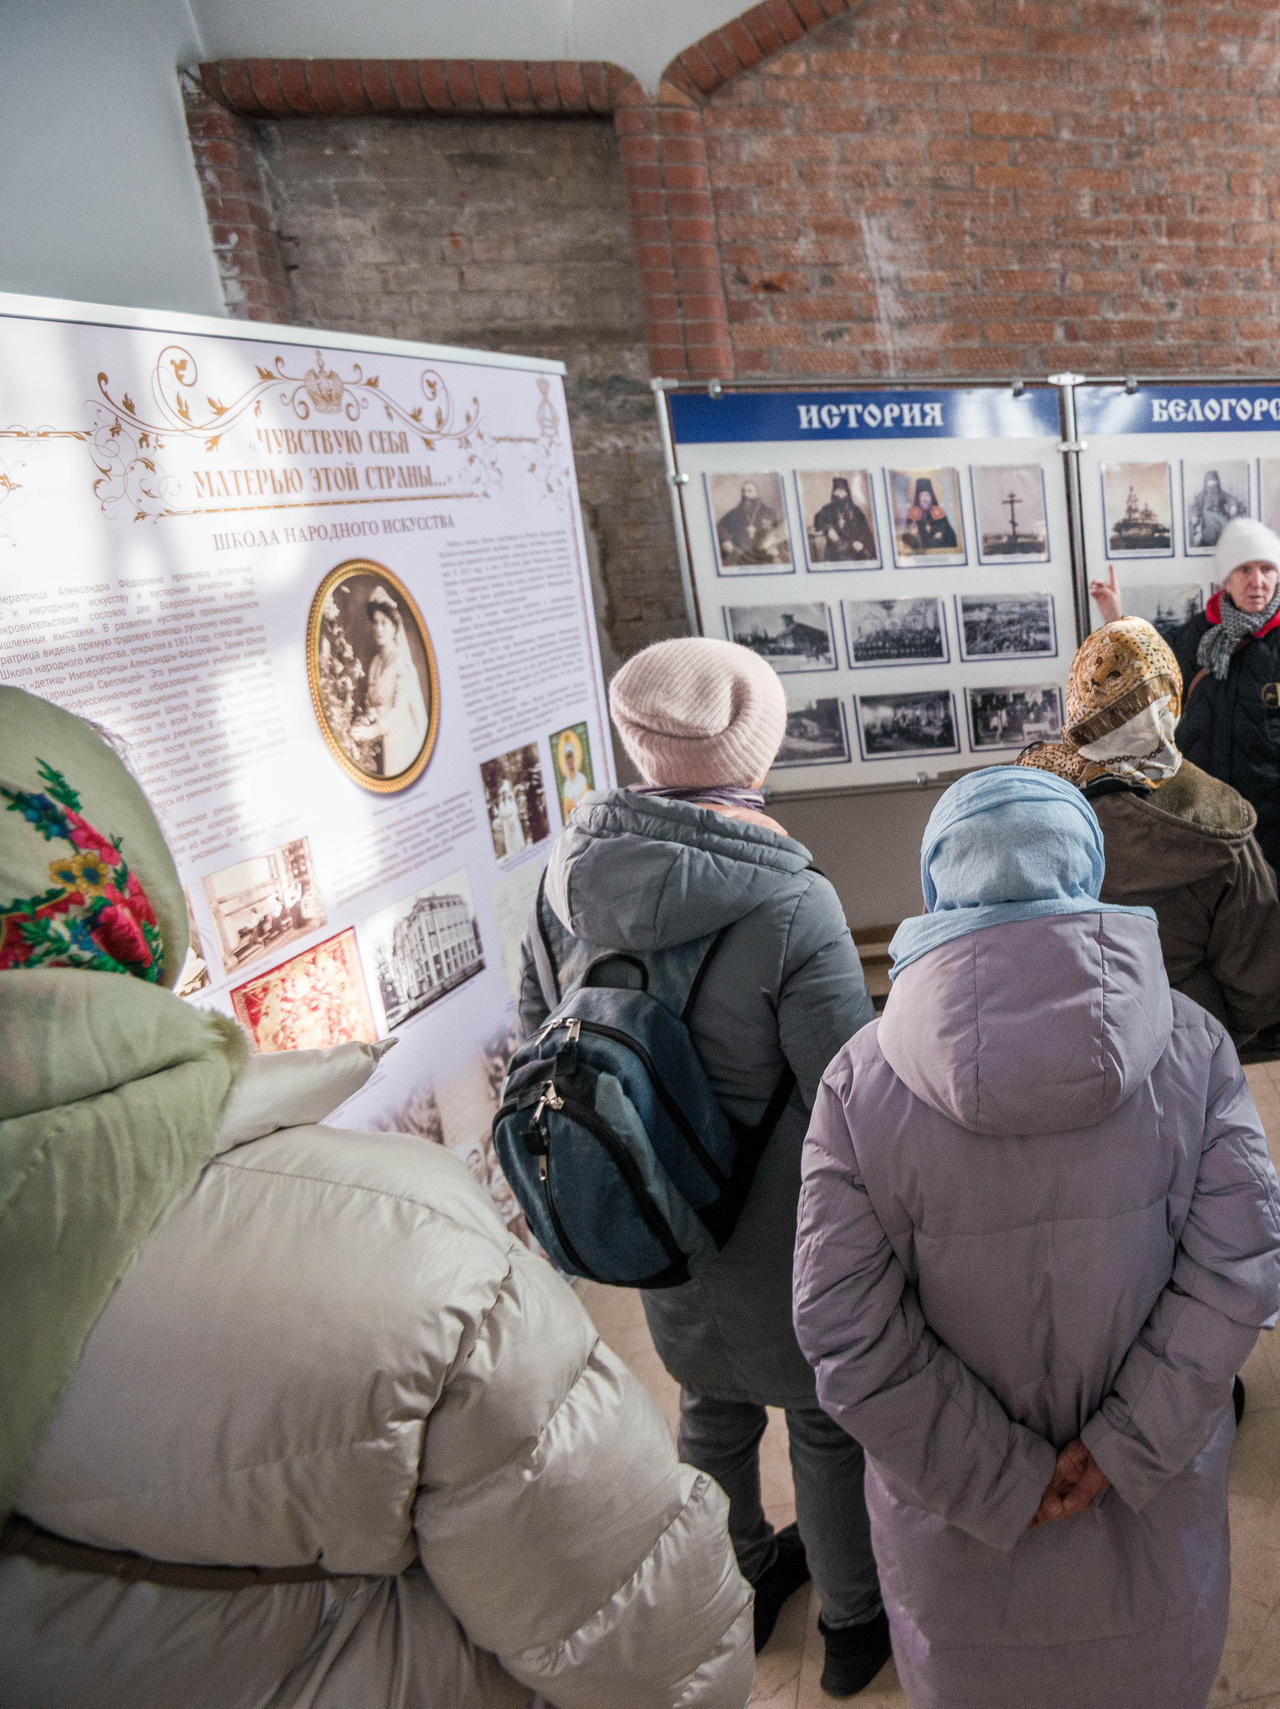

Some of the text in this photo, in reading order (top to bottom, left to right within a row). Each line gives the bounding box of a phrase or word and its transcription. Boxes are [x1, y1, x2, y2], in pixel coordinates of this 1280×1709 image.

[797, 402, 944, 429] ИСТОРИЯ
[249, 428, 410, 455] «ЧУВСТВУЮ СЕБЯ
[193, 467, 304, 499] МАТЕРЬЮ
[309, 462, 360, 493] ЭТОЙ
[212, 513, 455, 551] ШКОЛА НАРОДНОГО ИСКУССТВА
[28, 601, 80, 616] народному
[88, 593, 129, 608] искусству
[150, 586, 191, 600] кустарным
[58, 582, 111, 597] Александра
[52, 627, 98, 642] выставки.
[102, 623, 109, 633] В
[114, 617, 153, 632] развитии
[157, 609, 196, 625] кустарной
[200, 601, 260, 618] промышленности
[89, 608, 127, 621] состояло
[137, 605, 151, 615] две
[43, 645, 76, 658] видела
[78, 638, 112, 652] прямую
[113, 631, 150, 647] трудовую
[152, 627, 184, 640] помощь
[184, 620, 218, 634] русскому
[1, 666, 33, 680] Школа
[35, 657, 84, 674] народного
[131, 642, 167, 657] открытая
[174, 636, 194, 648] 1911
[68, 664, 129, 681] Императрицы
[129, 653, 177, 670] Александры
[224, 639, 246, 651] Также
[151, 669, 165, 679] Это
[167, 660, 211, 677] уникальное
[212, 652, 242, 667] учебное
[130, 690, 189, 710] традиционного
[111, 709, 161, 728] окончившие
[156, 722, 167, 732] по
[170, 715, 189, 727] всей
[192, 708, 219, 721] России
[209, 719, 215, 730] В
[147, 750, 160, 760] лет
[163, 742, 186, 755] после
[170, 763, 200, 779] Полный
[203, 758, 219, 770] курс
[186, 785, 213, 801] умение
